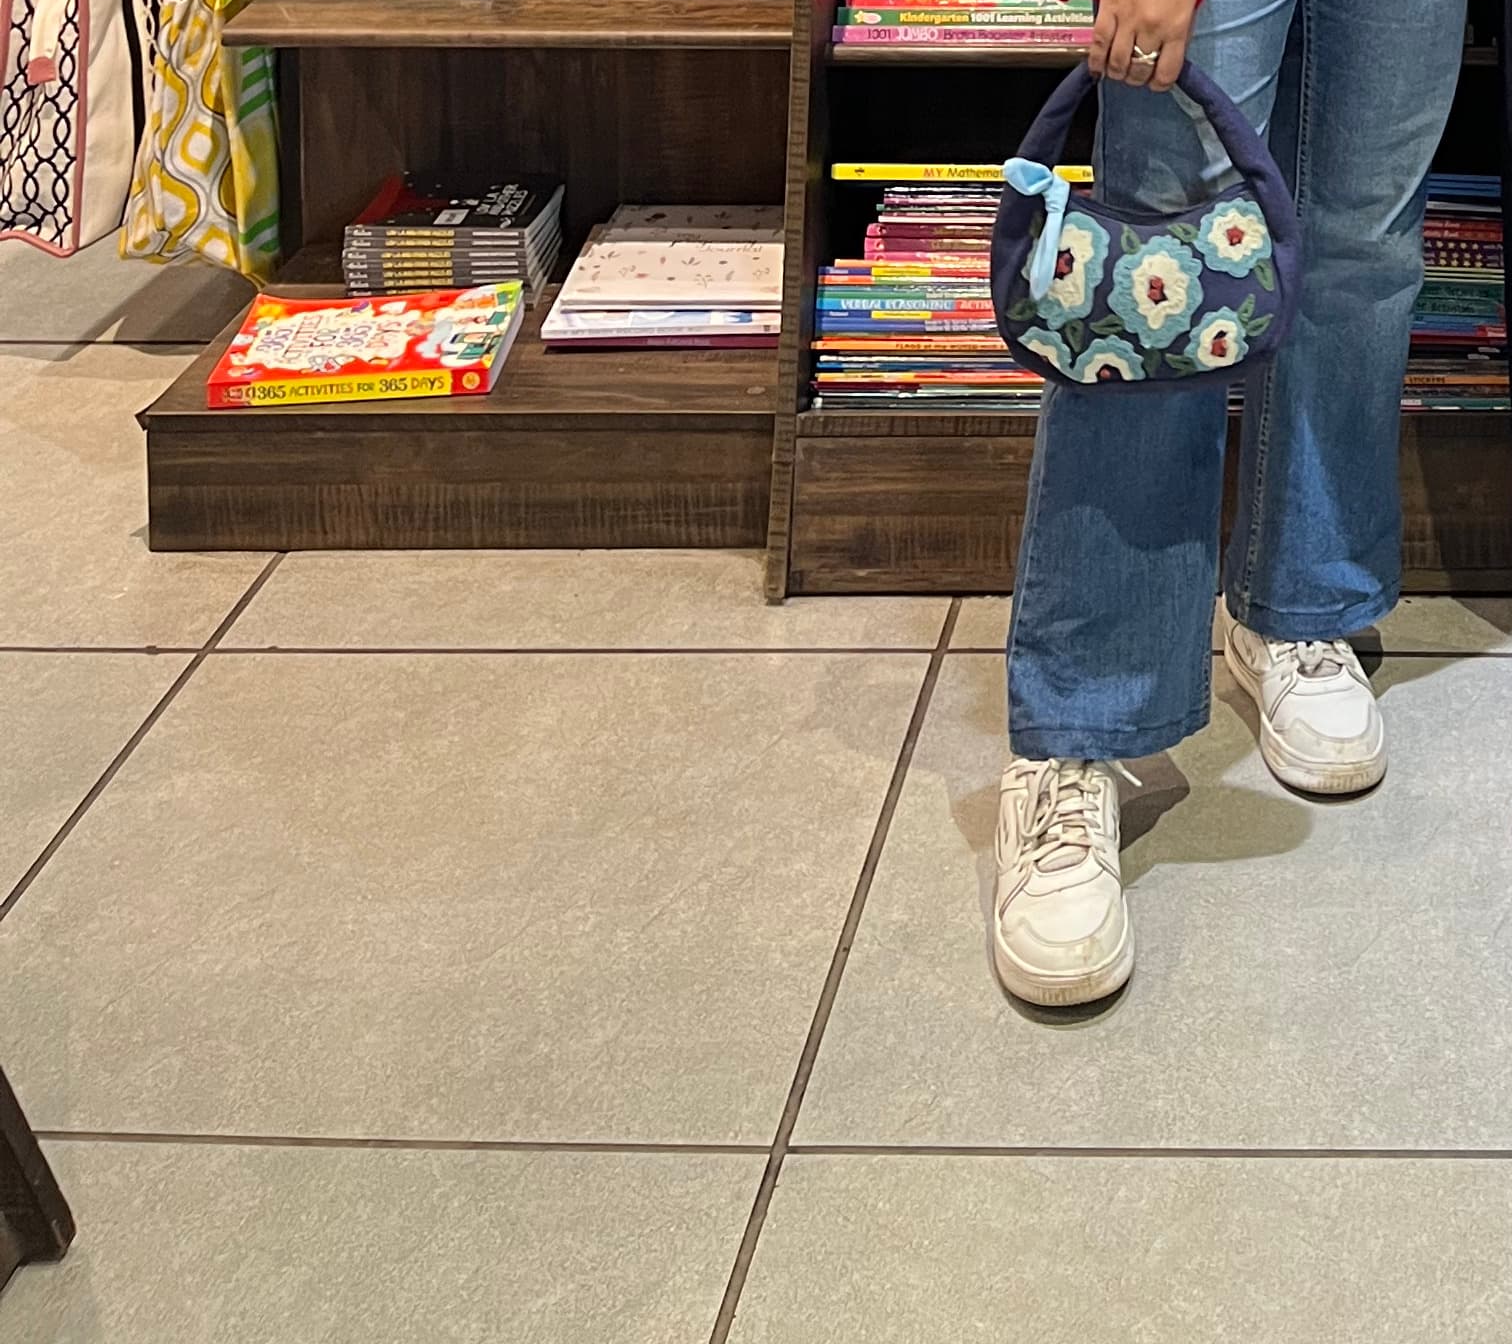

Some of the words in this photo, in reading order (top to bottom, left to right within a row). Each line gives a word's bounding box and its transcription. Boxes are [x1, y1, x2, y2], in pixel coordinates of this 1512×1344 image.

[899, 11, 969, 24] Kindergarten
[867, 28, 892, 40] 1001
[923, 167, 943, 178] MY
[256, 383, 287, 400] 365
[288, 381, 354, 397] ACTIVITIES
[356, 381, 375, 392] FOR
[378, 377, 408, 393] 365
[410, 376, 445, 391] DAYS
